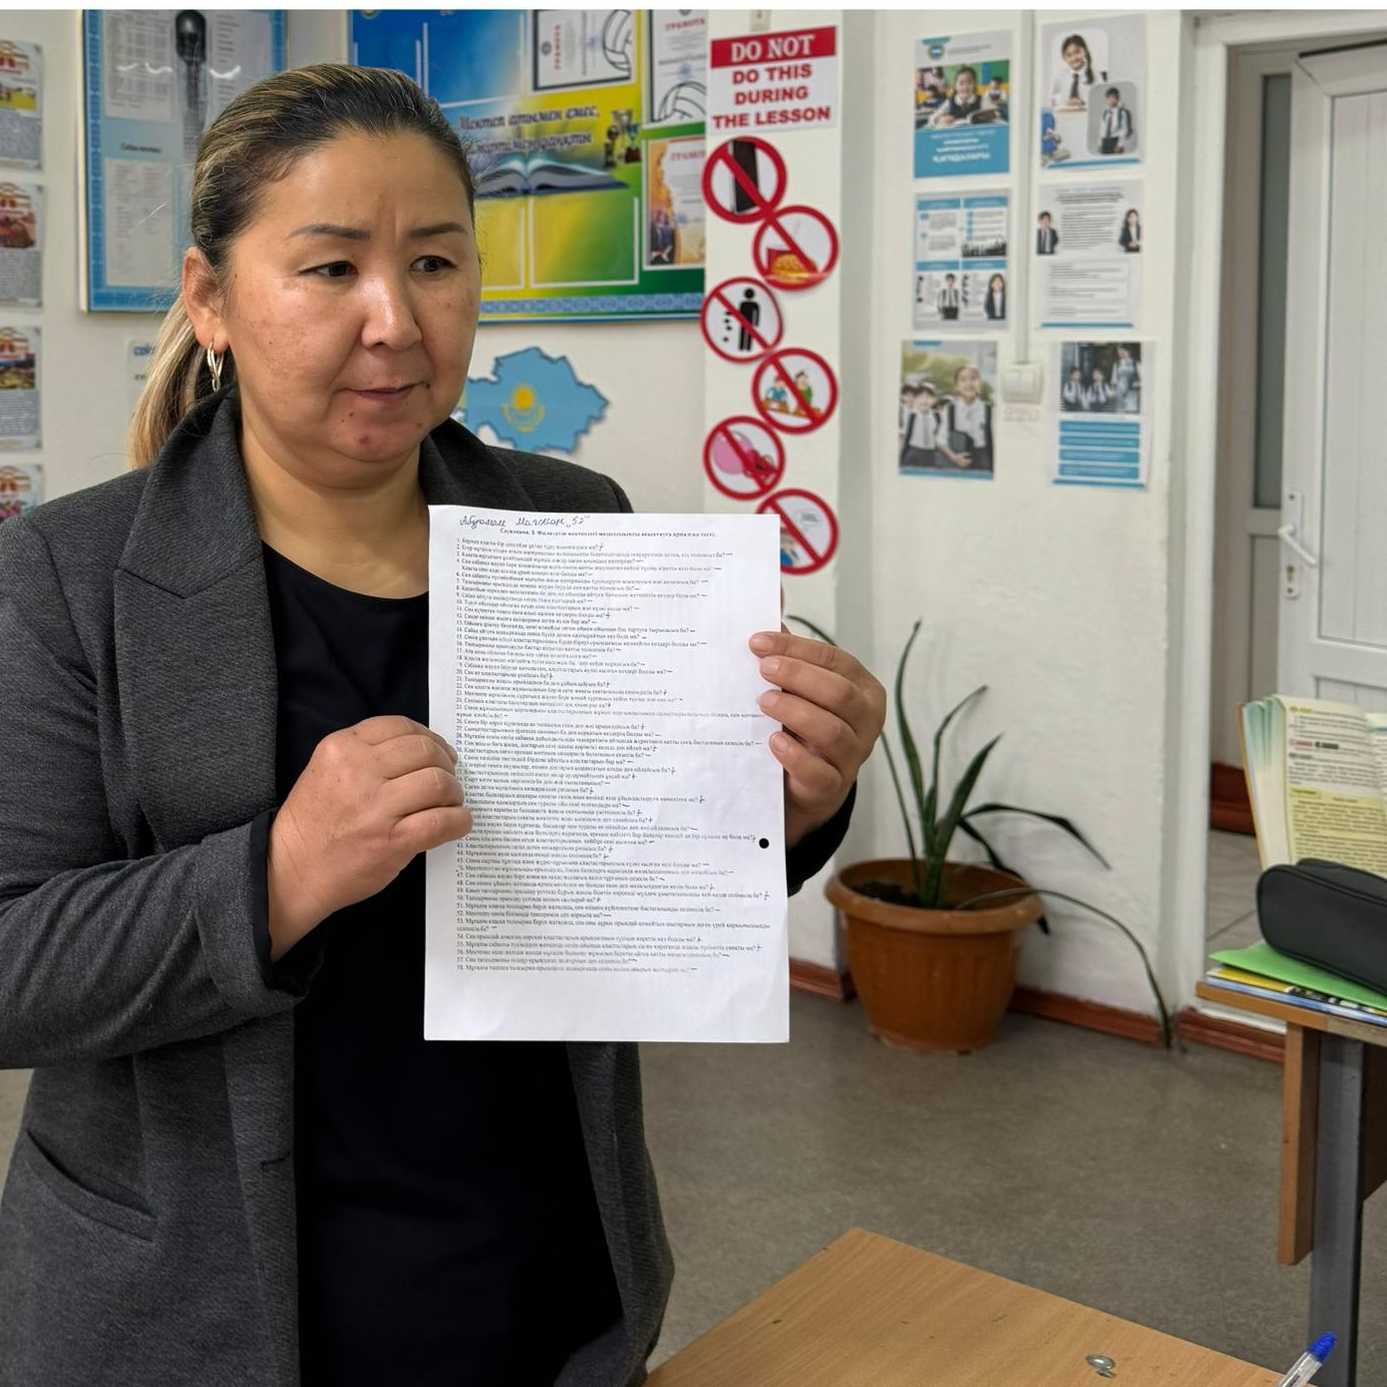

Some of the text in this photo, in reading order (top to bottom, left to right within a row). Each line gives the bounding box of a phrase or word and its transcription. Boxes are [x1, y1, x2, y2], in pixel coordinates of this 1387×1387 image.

[731, 34, 815, 63] DO NOT
[732, 64, 812, 85] DO THIS
[734, 86, 809, 105] DURING
[712, 106, 831, 129] THE LESSON
